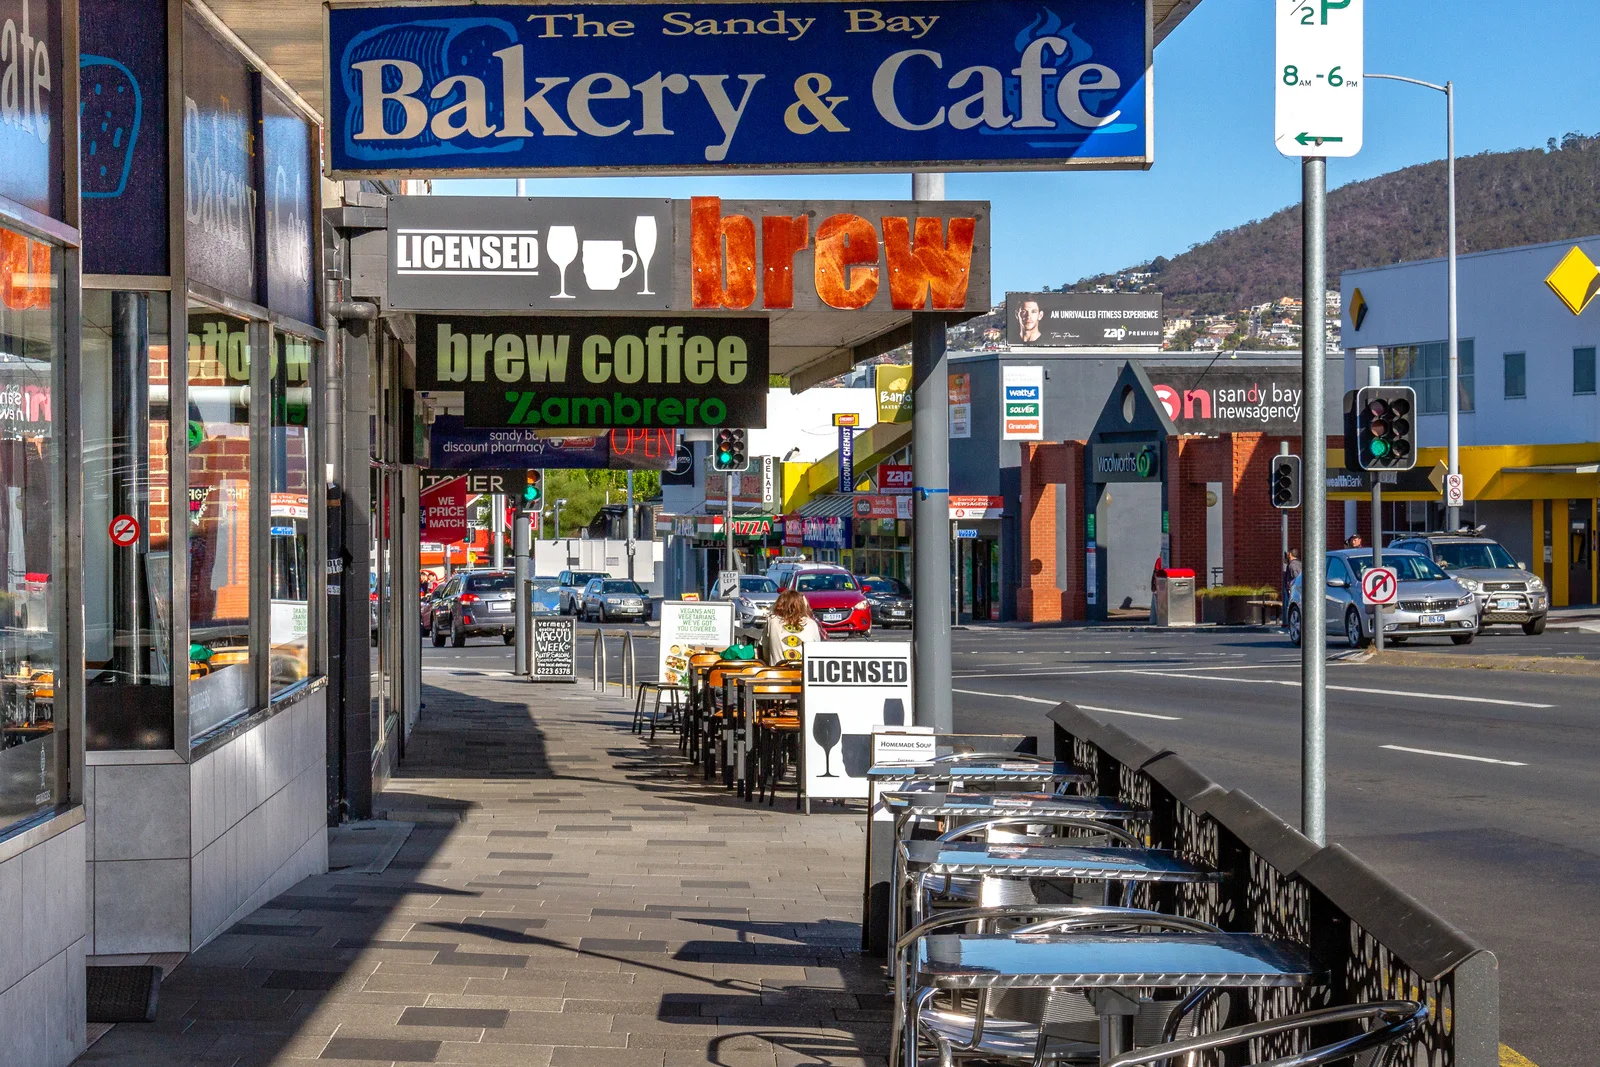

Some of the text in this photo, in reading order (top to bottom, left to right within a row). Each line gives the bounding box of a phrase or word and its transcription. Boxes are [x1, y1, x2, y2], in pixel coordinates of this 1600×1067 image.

[527, 9, 940, 41] The Sandy Bay
[351, 43, 766, 162] Bakery
[783, 72, 851, 135] &
[871, 36, 1121, 131] Cafe
[397, 235, 539, 269] LICENSED
[691, 196, 976, 310] brew
[1050, 310, 1159, 319] AN UNRIVALLED FITNESS EXPERIENCE
[1103, 328, 1126, 341] zap
[437, 323, 748, 384] brew coffee
[1218, 382, 1302, 407] sandy bay
[505, 391, 727, 425] Zambrero
[1009, 404, 1036, 413] SOLVER
[1218, 405, 1301, 423] newsagency
[489, 430, 524, 443] sandy
[611, 429, 676, 458] OPEN
[843, 427, 851, 456] CHEMIST
[443, 441, 545, 454] discount pharmacy
[1098, 453, 1136, 473] Woolworths
[843, 458, 851, 492] DISCOUNT
[887, 470, 912, 486] zap
[438, 496, 454, 505] WE
[429, 506, 465, 517] PRICE
[429, 519, 465, 528] MATCH
[678, 613, 717, 621] VEGETARIANS,
[535, 630, 571, 642] WAGYU
[537, 641, 565, 652] WEEK
[537, 667, 554, 675] 6223
[808, 660, 908, 683] LICENSED
